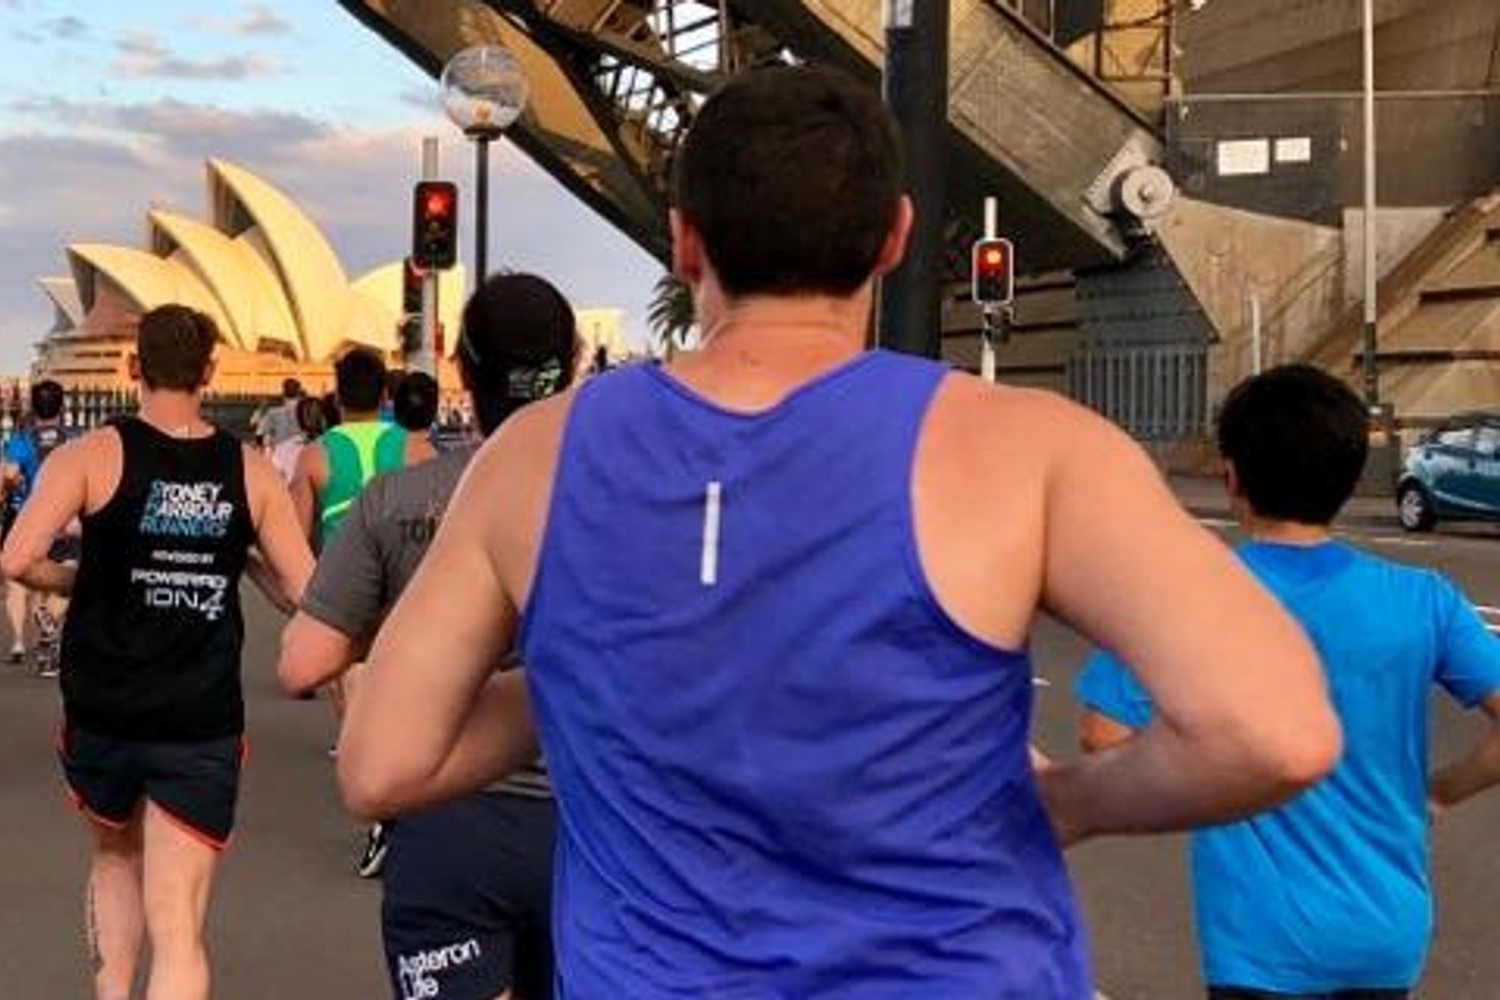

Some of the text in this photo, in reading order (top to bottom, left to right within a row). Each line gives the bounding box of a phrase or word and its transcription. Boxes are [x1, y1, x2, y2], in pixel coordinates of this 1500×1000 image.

[150, 479, 223, 503] SYDNEY
[144, 498, 233, 520] HARBOUR
[139, 515, 227, 537] RUNNERS
[398, 938, 482, 975] Asteron
